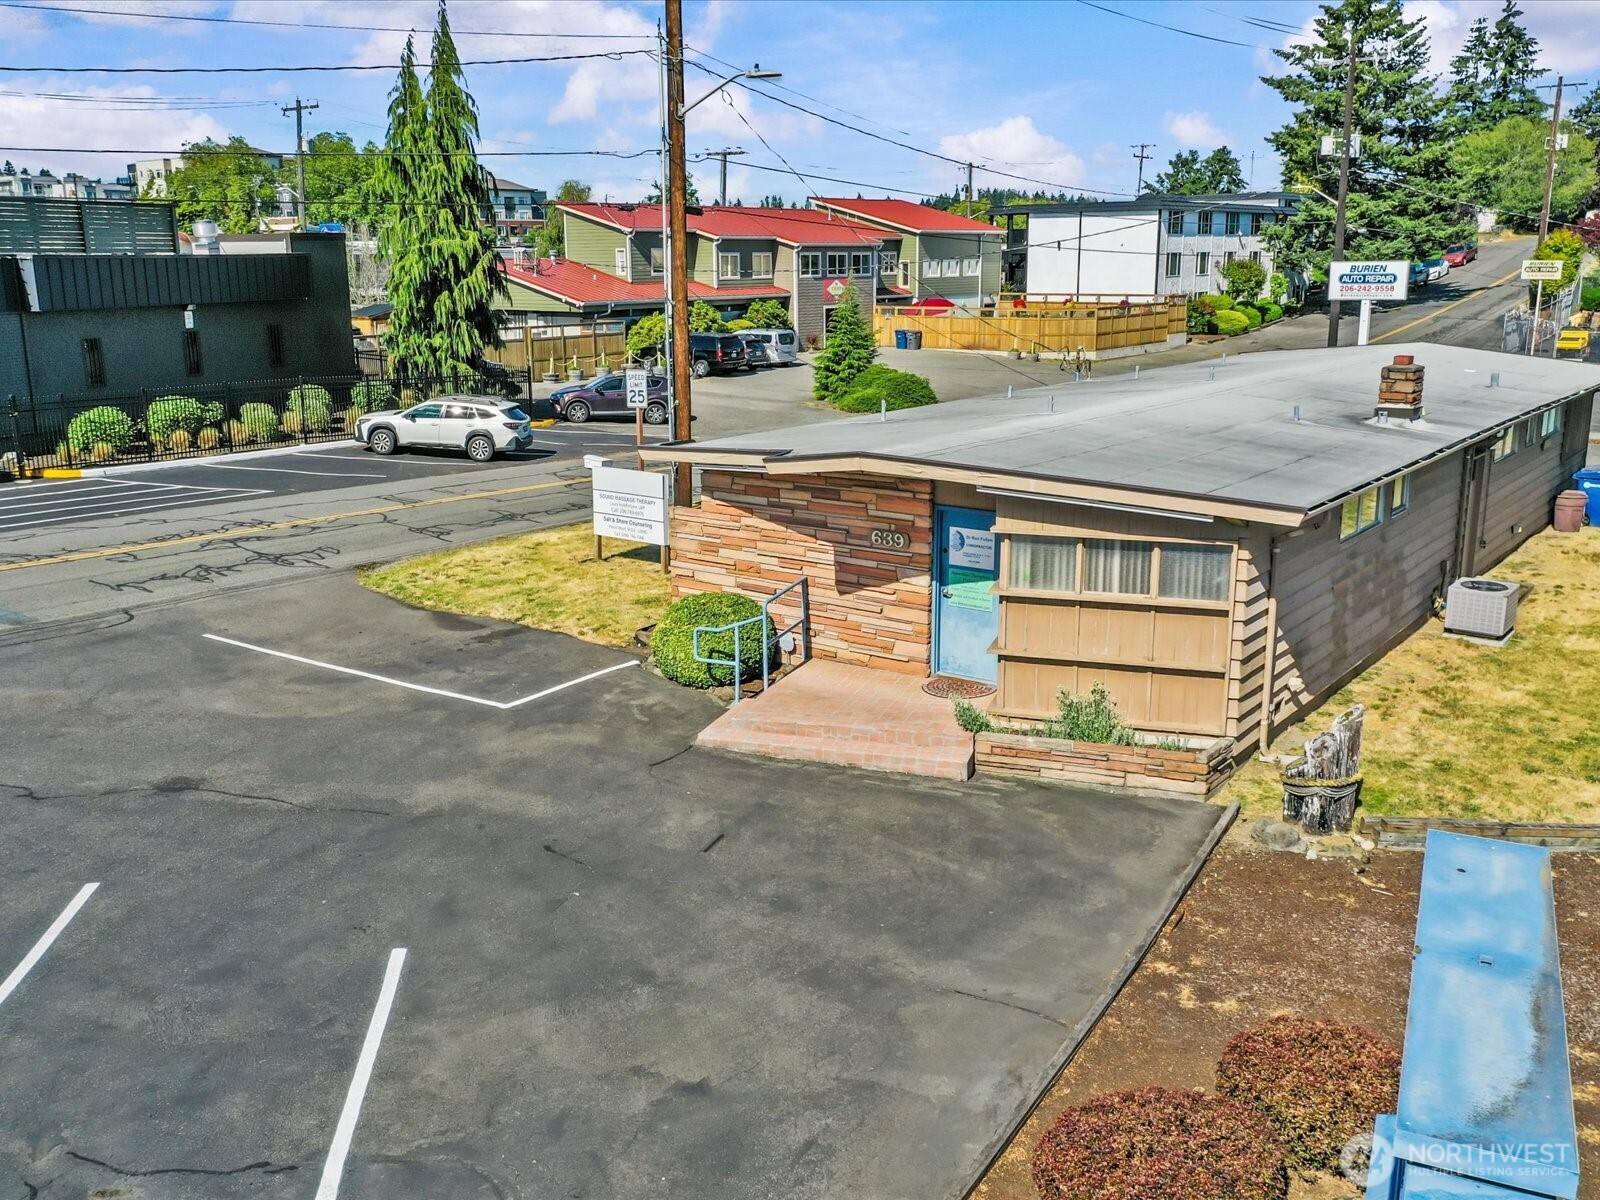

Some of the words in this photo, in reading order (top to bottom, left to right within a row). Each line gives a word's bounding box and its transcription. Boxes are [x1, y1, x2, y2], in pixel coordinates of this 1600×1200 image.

[1350, 265, 1388, 273] BURIEN
[1341, 275, 1364, 283] AUTO
[1365, 275, 1394, 283] REPAIR
[629, 389, 645, 403] 25
[615, 495, 635, 503] MASSAGE
[636, 498, 656, 506] THERAPY
[629, 520, 653, 529] Counseling
[871, 530, 904, 548] 639
